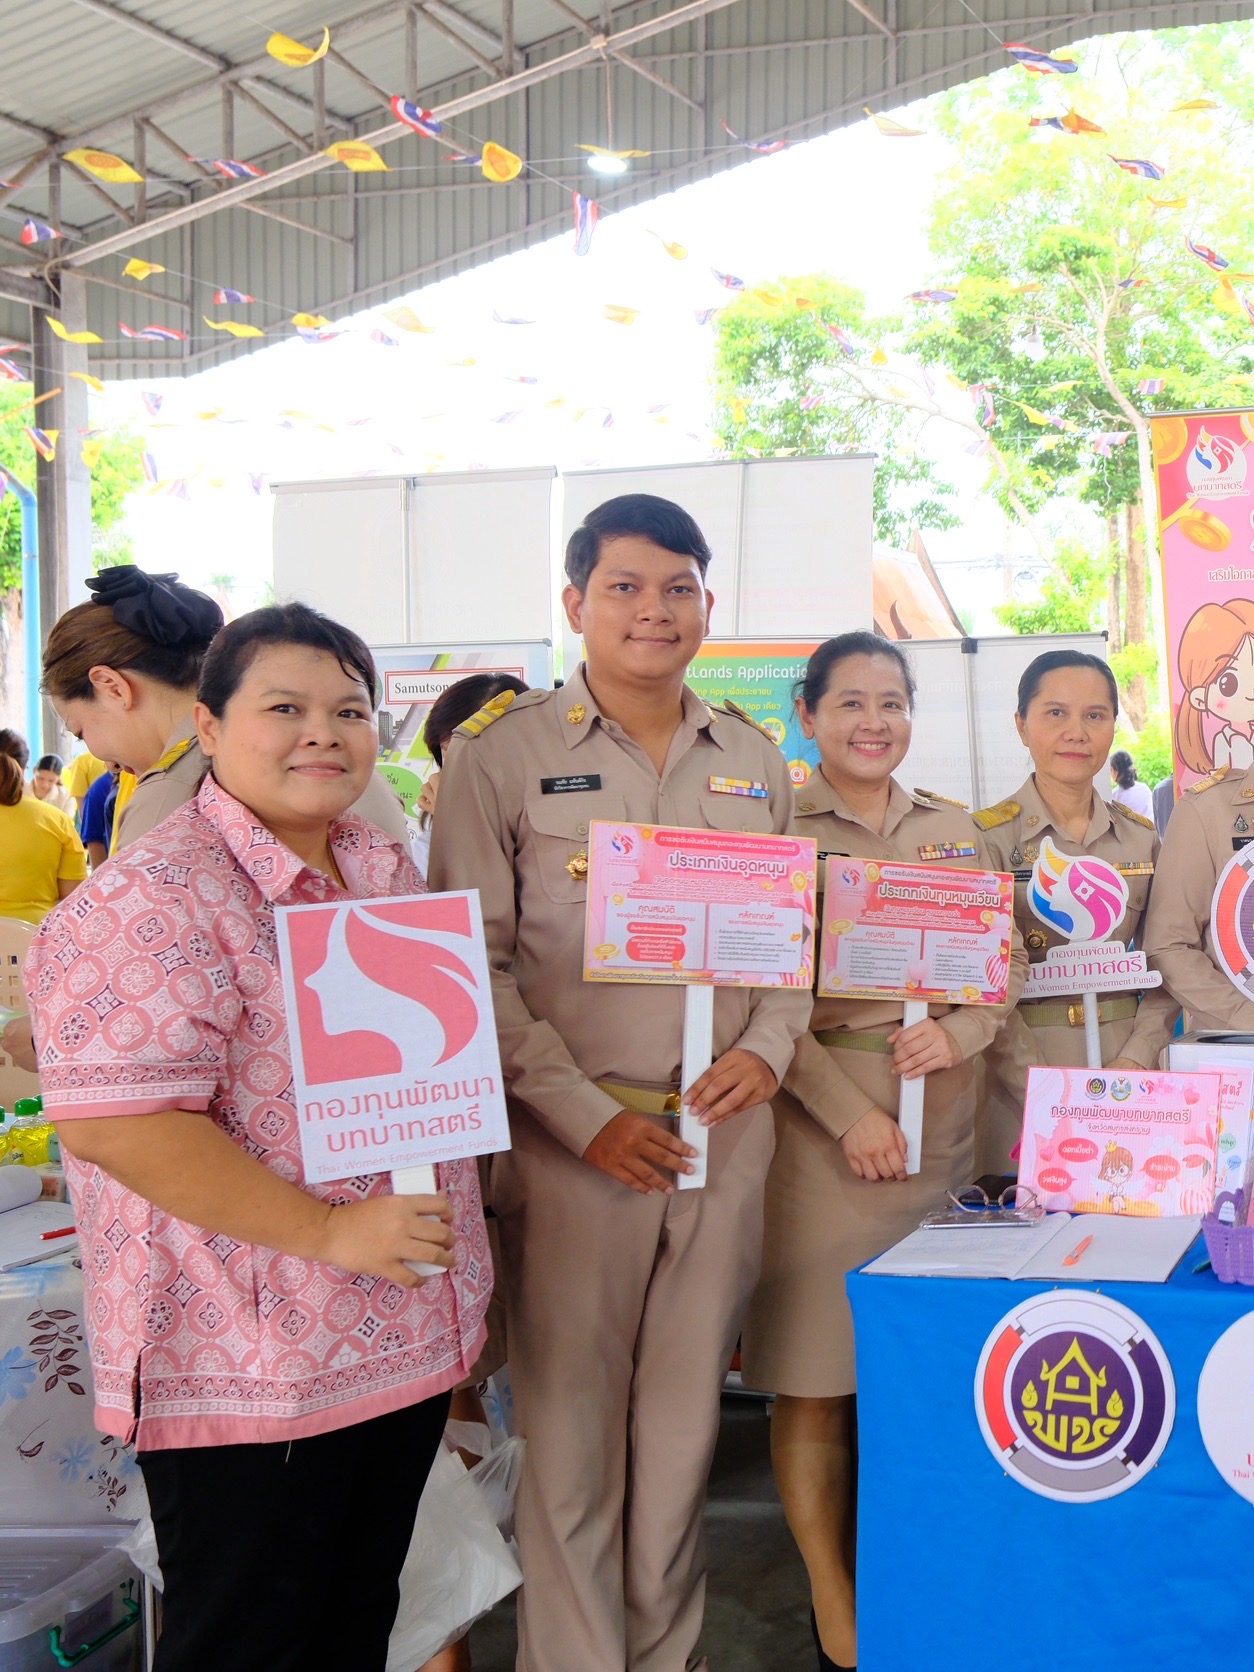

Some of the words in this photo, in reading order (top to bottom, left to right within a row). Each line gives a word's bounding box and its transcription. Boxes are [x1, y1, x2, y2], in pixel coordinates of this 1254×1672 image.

[686, 664, 733, 679] tLands
[738, 664, 808, 682] Applicatio
[394, 682, 450, 695] Samutson
[669, 852, 786, 877] ประเภทเงินอุดหนุน
[879, 883, 1000, 907] ประเภทเงินทุนหมุนเวียน
[638, 905, 676, 914] คุณสมบัติ
[738, 911, 775, 920] หลักเกณฑ์
[865, 931, 896, 940] คุณสมบัติ
[948, 936, 978, 945] หลักเกณฑ์
[1051, 945, 1121, 960] กองทุนพัฒนา
[1032, 954, 1143, 981] บทบาทสตรี
[1038, 984, 1070, 993] Women
[1072, 978, 1131, 990] Empowerment
[1133, 975, 1158, 985] Funds
[304, 1076, 496, 1123] กองทุนพัฒนา
[1051, 1104, 1191, 1123] กองทุนพัฒนาบทบาทสตรี
[326, 1103, 483, 1153] บทบาทสตรี
[1087, 1123, 1151, 1136] จังหวัดสมุทรสงคราม
[317, 1164, 341, 1176] Thai
[344, 1157, 386, 1172] Women
[389, 1144, 465, 1165] Empowerment
[468, 1137, 498, 1149] Funds
[1232, 1469, 1250, 1479] Thai
